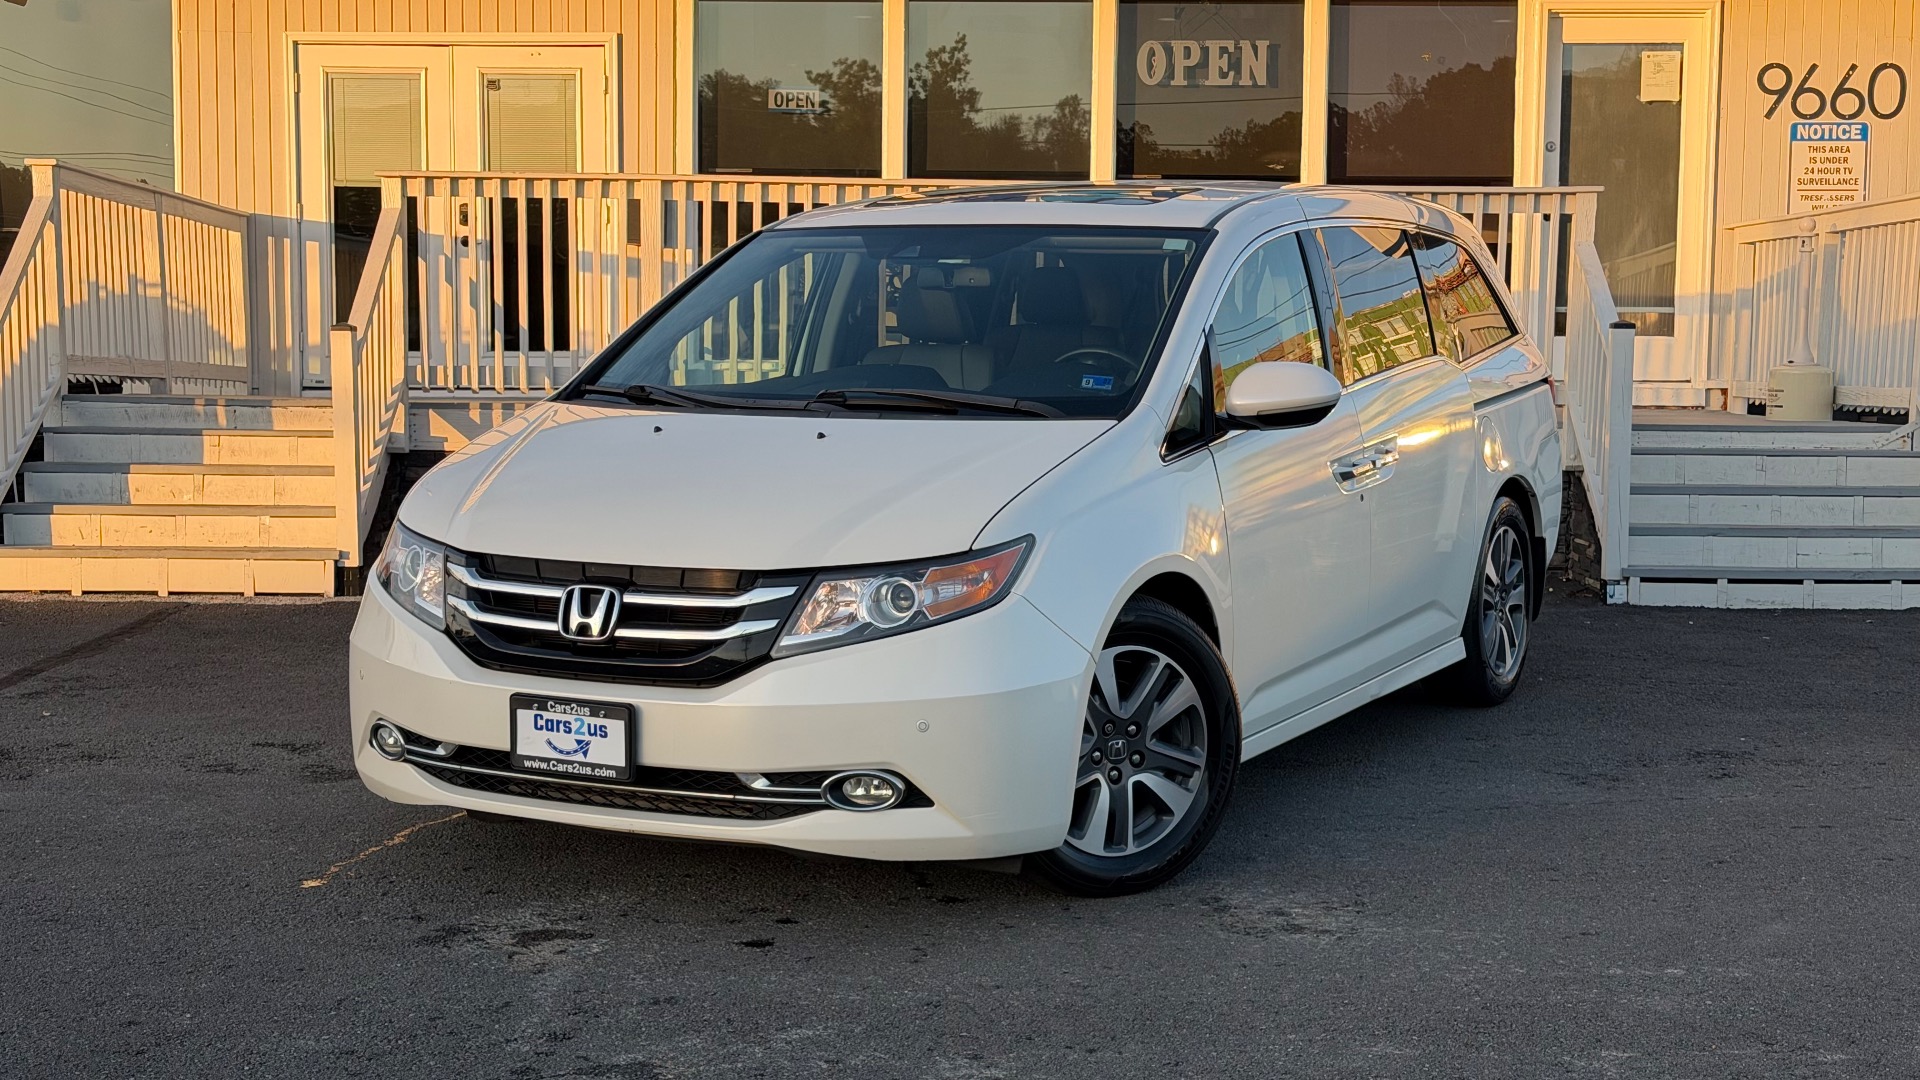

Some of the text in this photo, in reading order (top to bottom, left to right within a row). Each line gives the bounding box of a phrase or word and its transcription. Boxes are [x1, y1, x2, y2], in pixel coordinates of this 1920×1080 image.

[1137, 40, 1269, 86] OPEN
[1756, 62, 1908, 120] 9660
[774, 91, 816, 108] OPEN
[1796, 124, 1863, 140] NOTICE
[1808, 145, 1851, 154] THIS AREA
[1809, 156, 1849, 165] IS UNDER
[1803, 167, 1854, 175] 24 HOUR TV
[1796, 177, 1860, 186] SURVEILLANCE
[1800, 194, 1855, 202] TRESPSSERS
[547, 701, 591, 717] Cars2us
[533, 713, 609, 739] Cars2us
[523, 759, 617, 778] www.Cars2us.com
